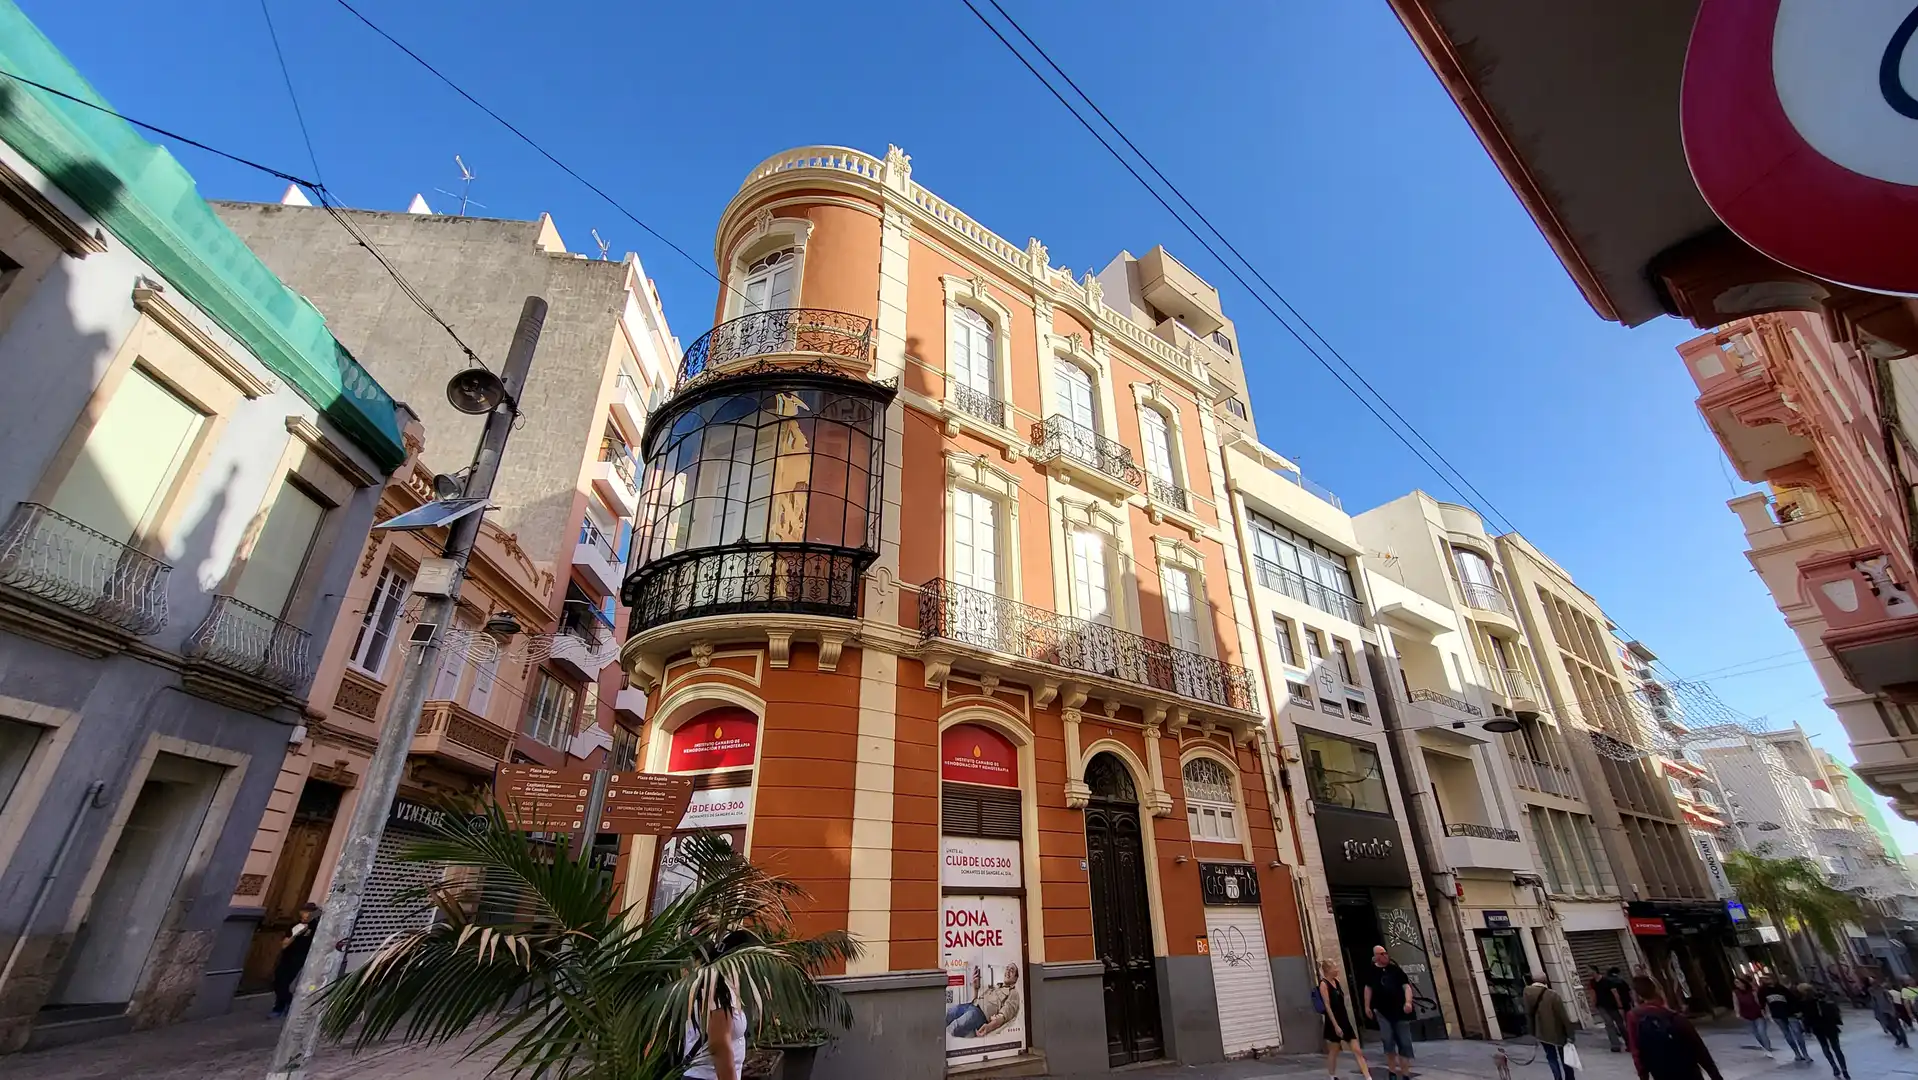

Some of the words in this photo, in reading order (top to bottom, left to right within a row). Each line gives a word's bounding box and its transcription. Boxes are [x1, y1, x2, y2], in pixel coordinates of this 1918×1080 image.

[698, 804, 710, 812] DE
[711, 802, 726, 811] LOS
[727, 801, 744, 810] 300
[397, 802, 446, 828] VINTAGE
[661, 855, 693, 867] Agos
[946, 855, 968, 866] CLUB
[969, 856, 979, 867] DE
[981, 857, 996, 867] LOS
[996, 857, 1011, 868] 300
[1700, 840, 1719, 876] CONSTANT
[945, 910, 989, 927] DONA
[945, 930, 1003, 948] SANGRE
[950, 959, 963, 967] 400
